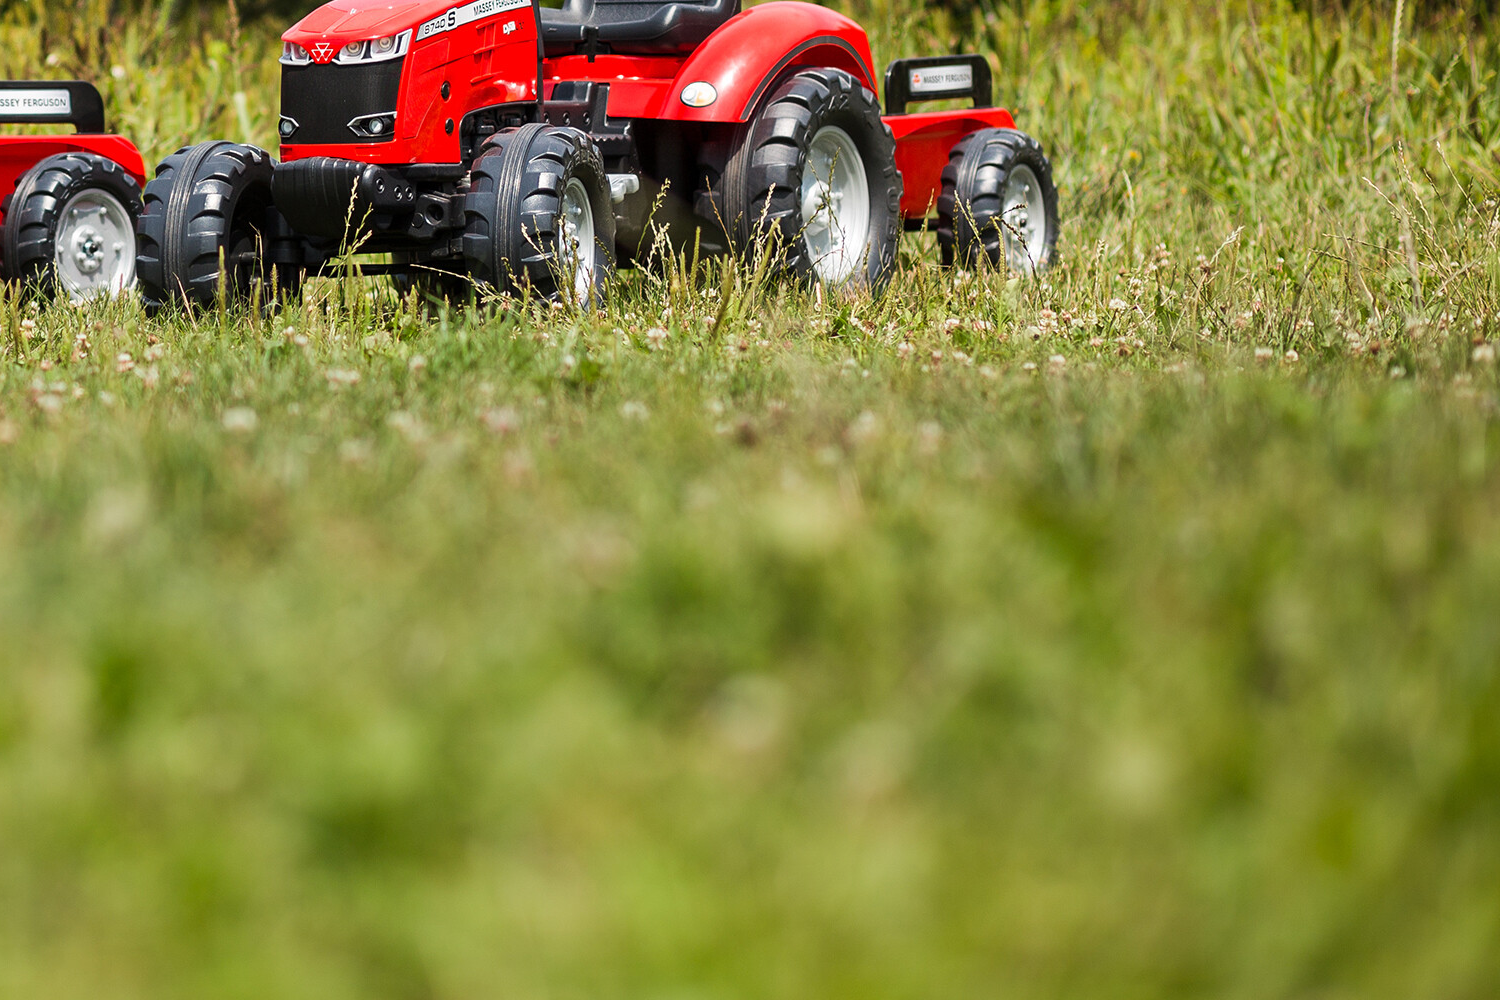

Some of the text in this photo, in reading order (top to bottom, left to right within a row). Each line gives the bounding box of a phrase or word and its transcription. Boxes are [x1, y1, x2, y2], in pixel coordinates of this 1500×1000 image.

[447, 11, 456, 27] S
[473, 2, 495, 16] MASSEY
[23, 98, 66, 107] FERGUSON
